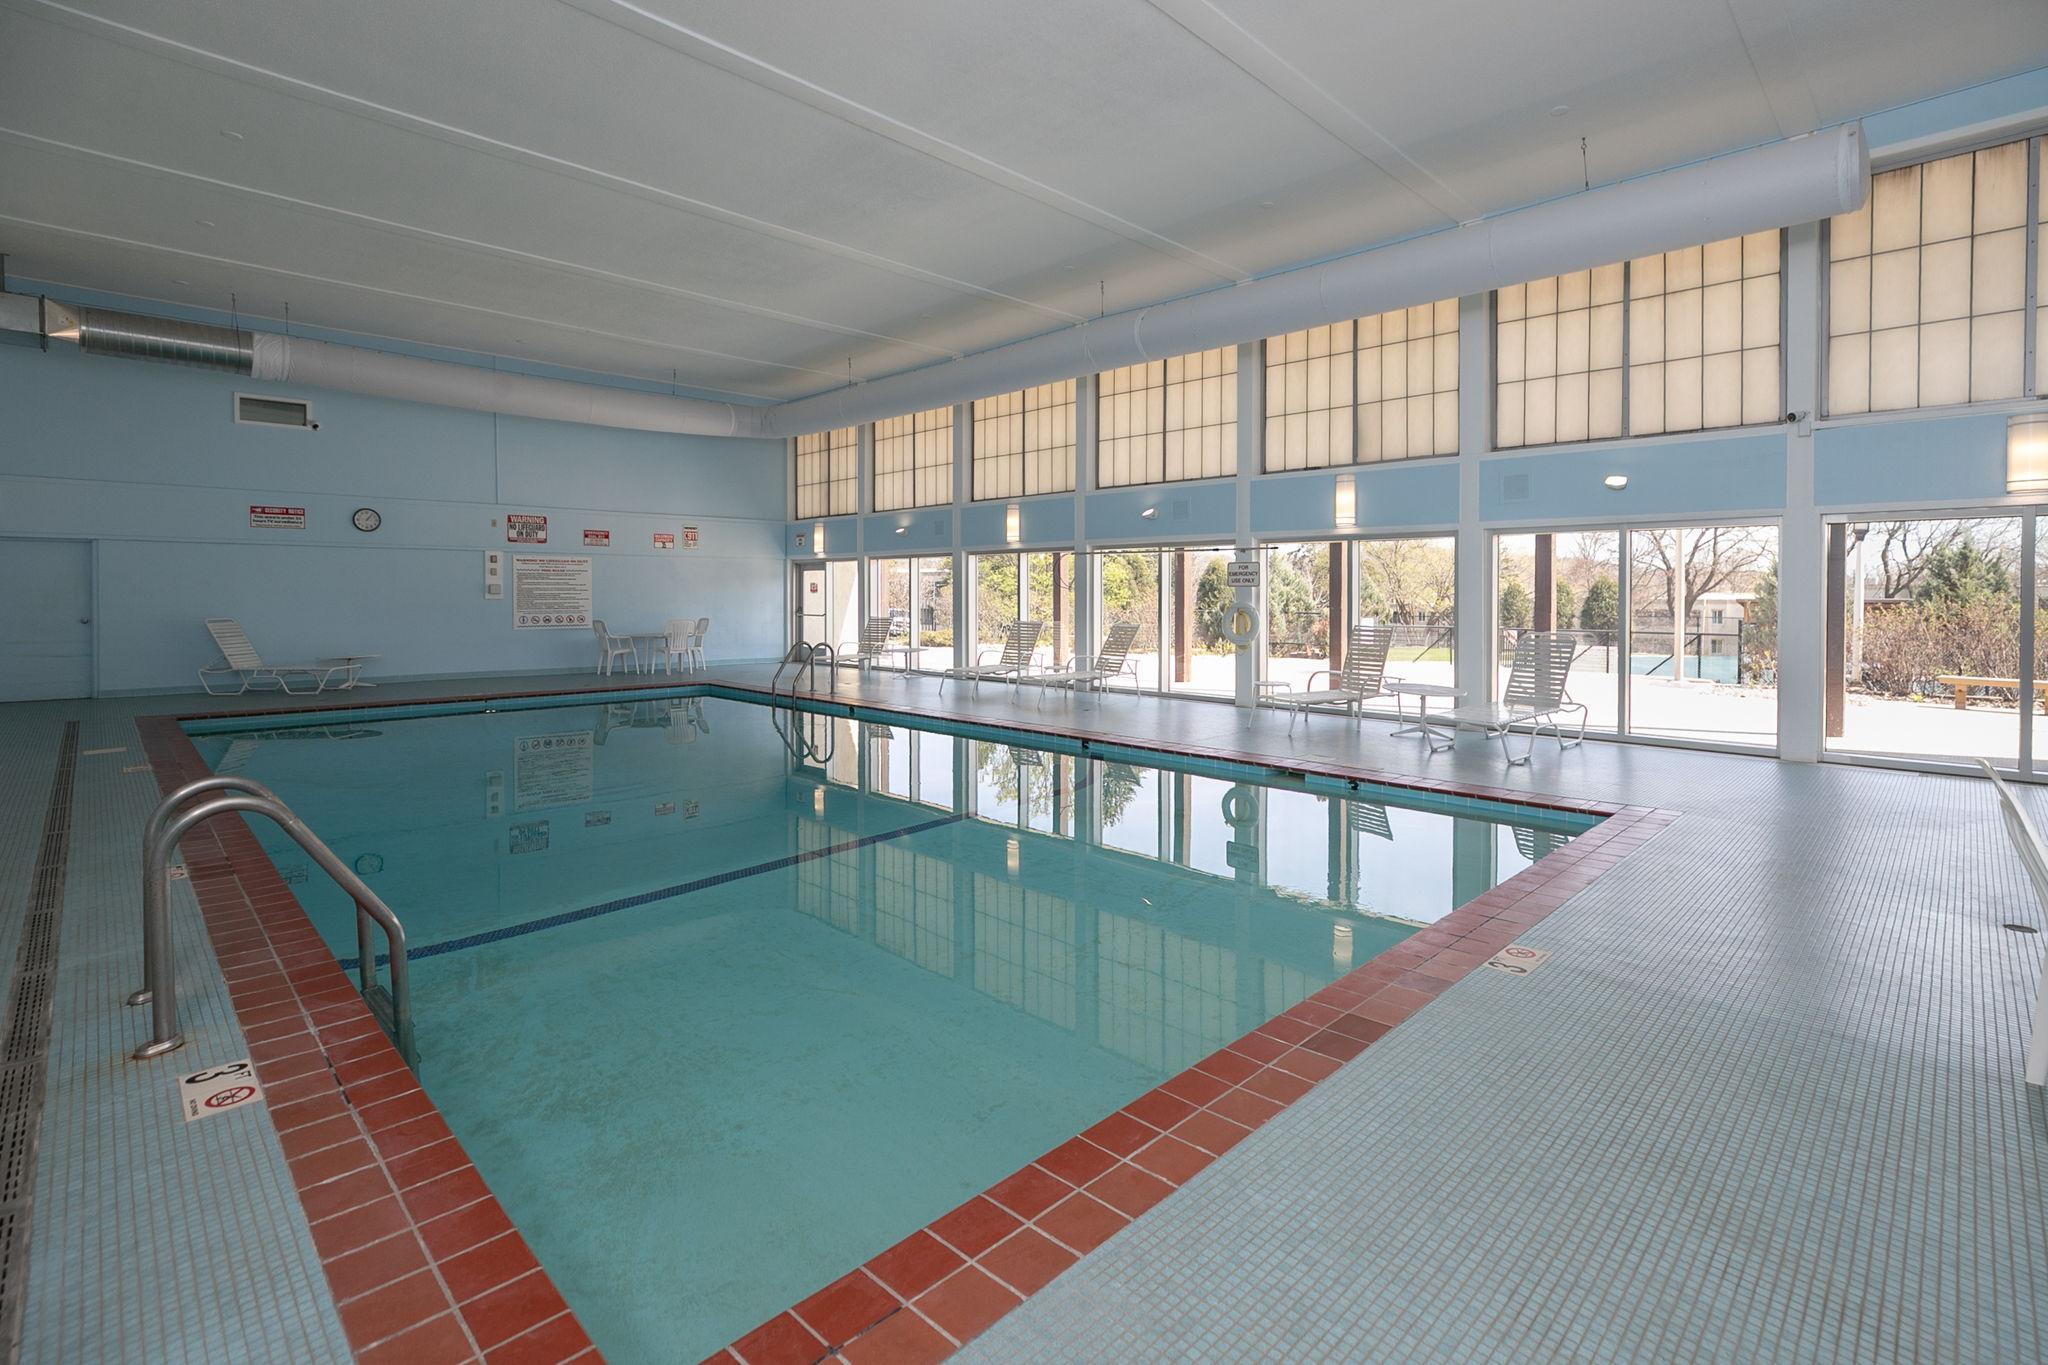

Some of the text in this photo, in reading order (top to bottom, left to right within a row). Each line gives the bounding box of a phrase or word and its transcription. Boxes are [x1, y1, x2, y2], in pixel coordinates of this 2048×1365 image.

[517, 524, 546, 532] LIFEGUARD
[516, 530, 538, 538] ON DUTY
[1488, 961, 1527, 973] 3
[185, 1063, 252, 1084] 3 FT
